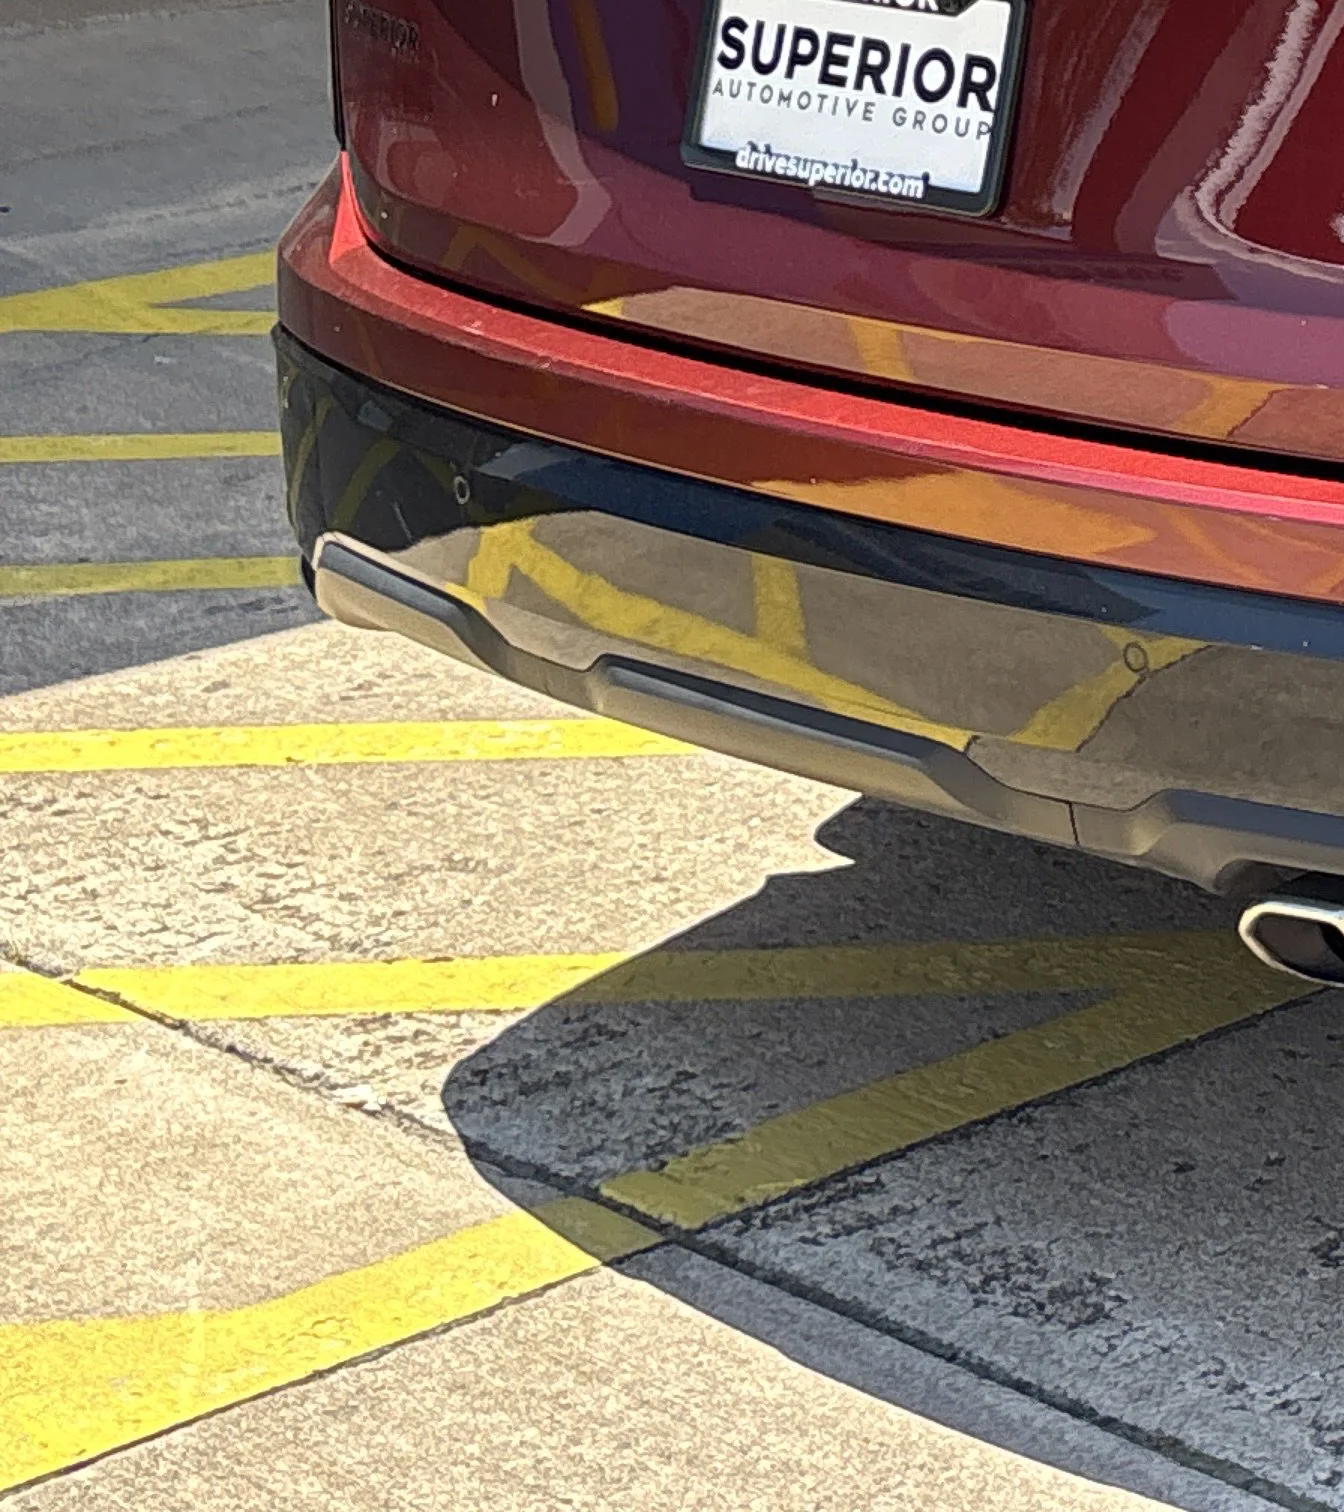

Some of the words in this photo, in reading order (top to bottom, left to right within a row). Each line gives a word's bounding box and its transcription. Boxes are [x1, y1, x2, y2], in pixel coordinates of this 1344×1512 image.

[716, 16, 998, 113] SUPERIOR
[712, 78, 876, 123] AUTOMOTIVE
[892, 107, 993, 141] GROUP
[735, 145, 925, 199] drivesuperior.com
